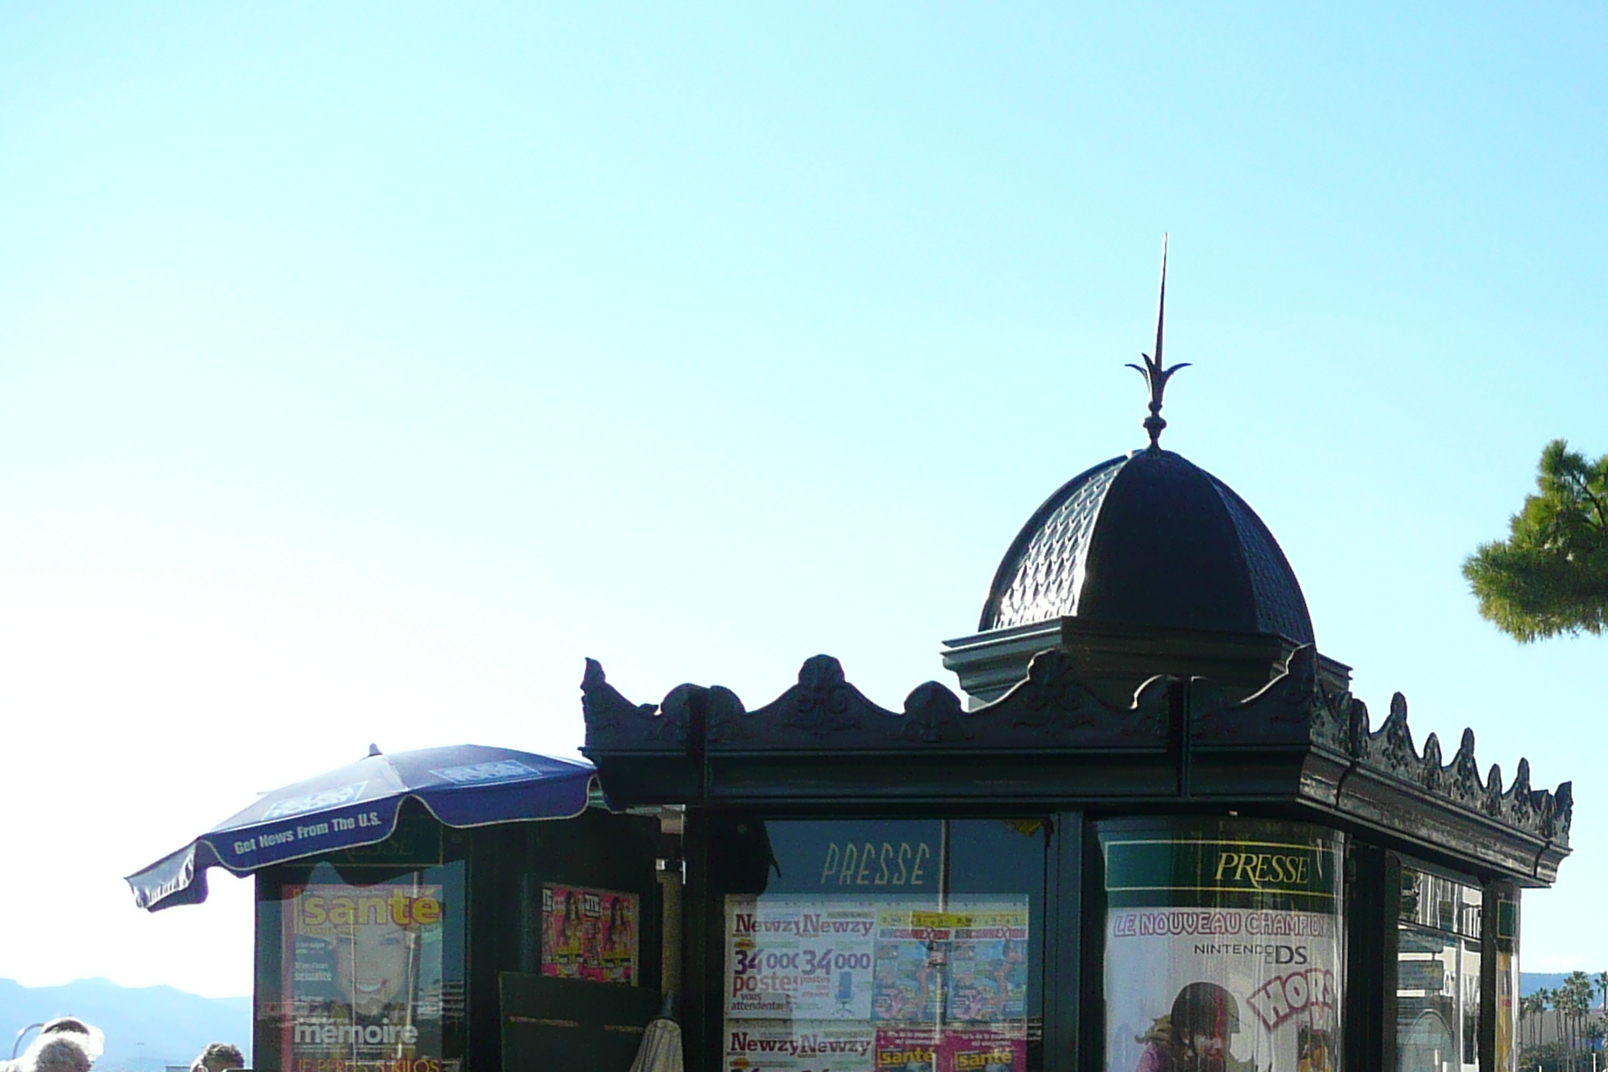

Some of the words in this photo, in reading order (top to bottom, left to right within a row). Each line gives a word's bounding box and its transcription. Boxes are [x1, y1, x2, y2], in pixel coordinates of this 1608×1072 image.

[233, 839, 257, 855] Get
[258, 829, 295, 849] News
[297, 821, 330, 840] From
[331, 816, 356, 832] The
[358, 811, 382, 828] U.S.
[820, 842, 930, 885] PRESSE
[1214, 851, 1310, 889] PRESSE
[303, 888, 441, 926] santé
[802, 913, 874, 937] Newzy
[1113, 913, 1138, 938] LE
[1140, 912, 1242, 935] NOUVEAU
[733, 949, 764, 975] 34
[802, 949, 833, 976] 34
[834, 953, 871, 970] 000
[1275, 944, 1309, 965] DS
[730, 1000, 776, 1010] attendent
[293, 1017, 419, 1044] mémoire
[730, 1032, 798, 1056] Newzy
[799, 1033, 872, 1057] Newzy
[880, 1046, 933, 1065] santé
[957, 1048, 1013, 1067] santé
